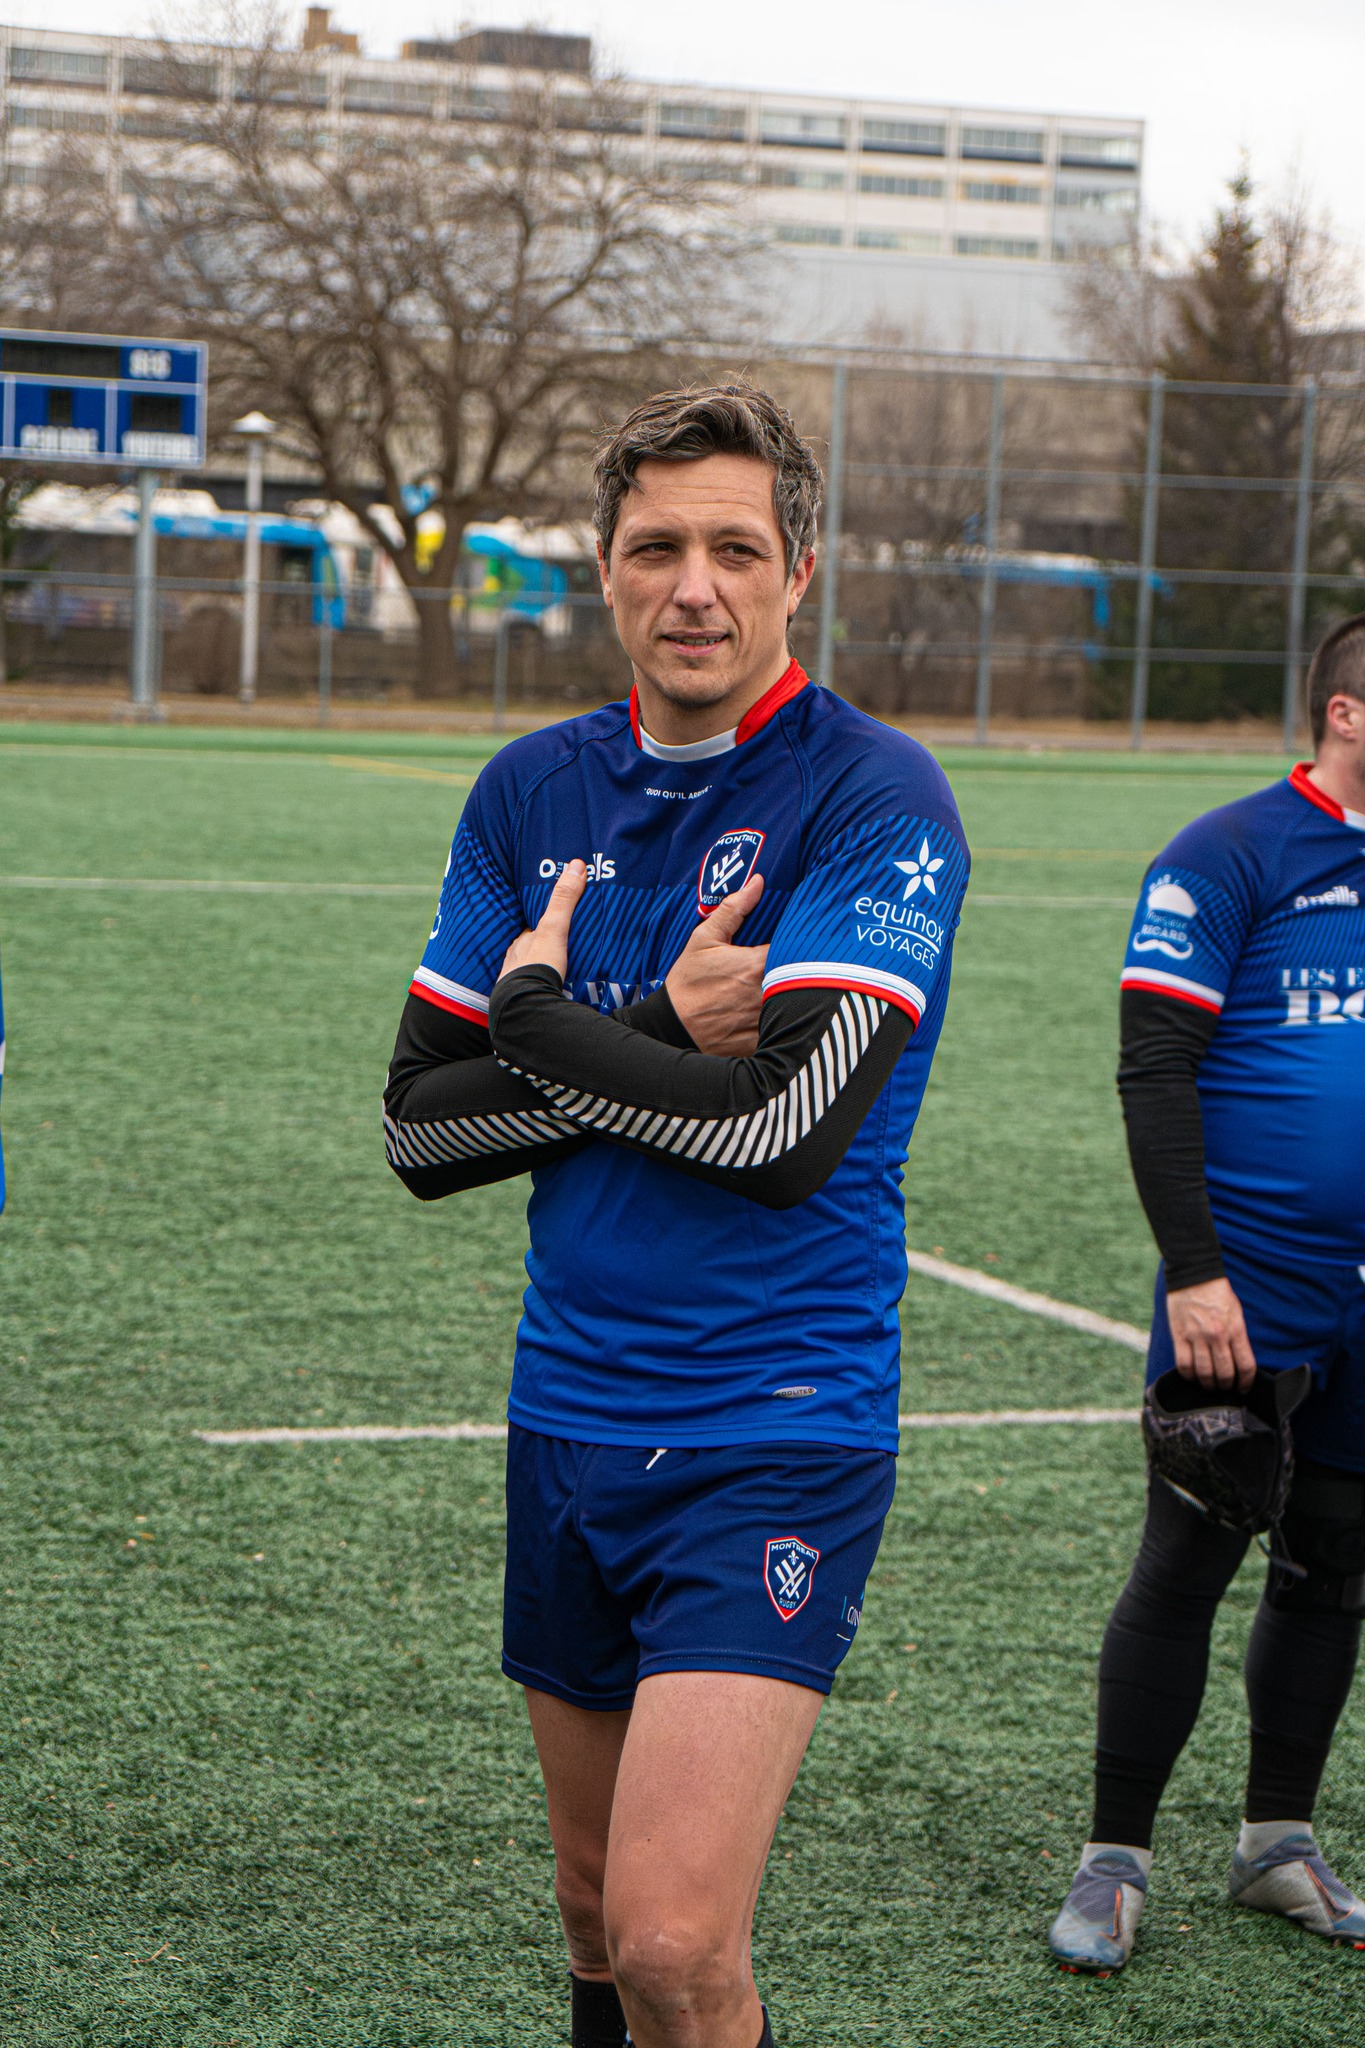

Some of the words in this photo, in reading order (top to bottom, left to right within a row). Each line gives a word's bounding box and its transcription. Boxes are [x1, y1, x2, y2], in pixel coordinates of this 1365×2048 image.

[855, 896, 945, 947] equinox
[1140, 924, 1187, 943] RICARD
[856, 924, 936, 970] VOYAGES
[778, 1597, 798, 1609] RUGBY
